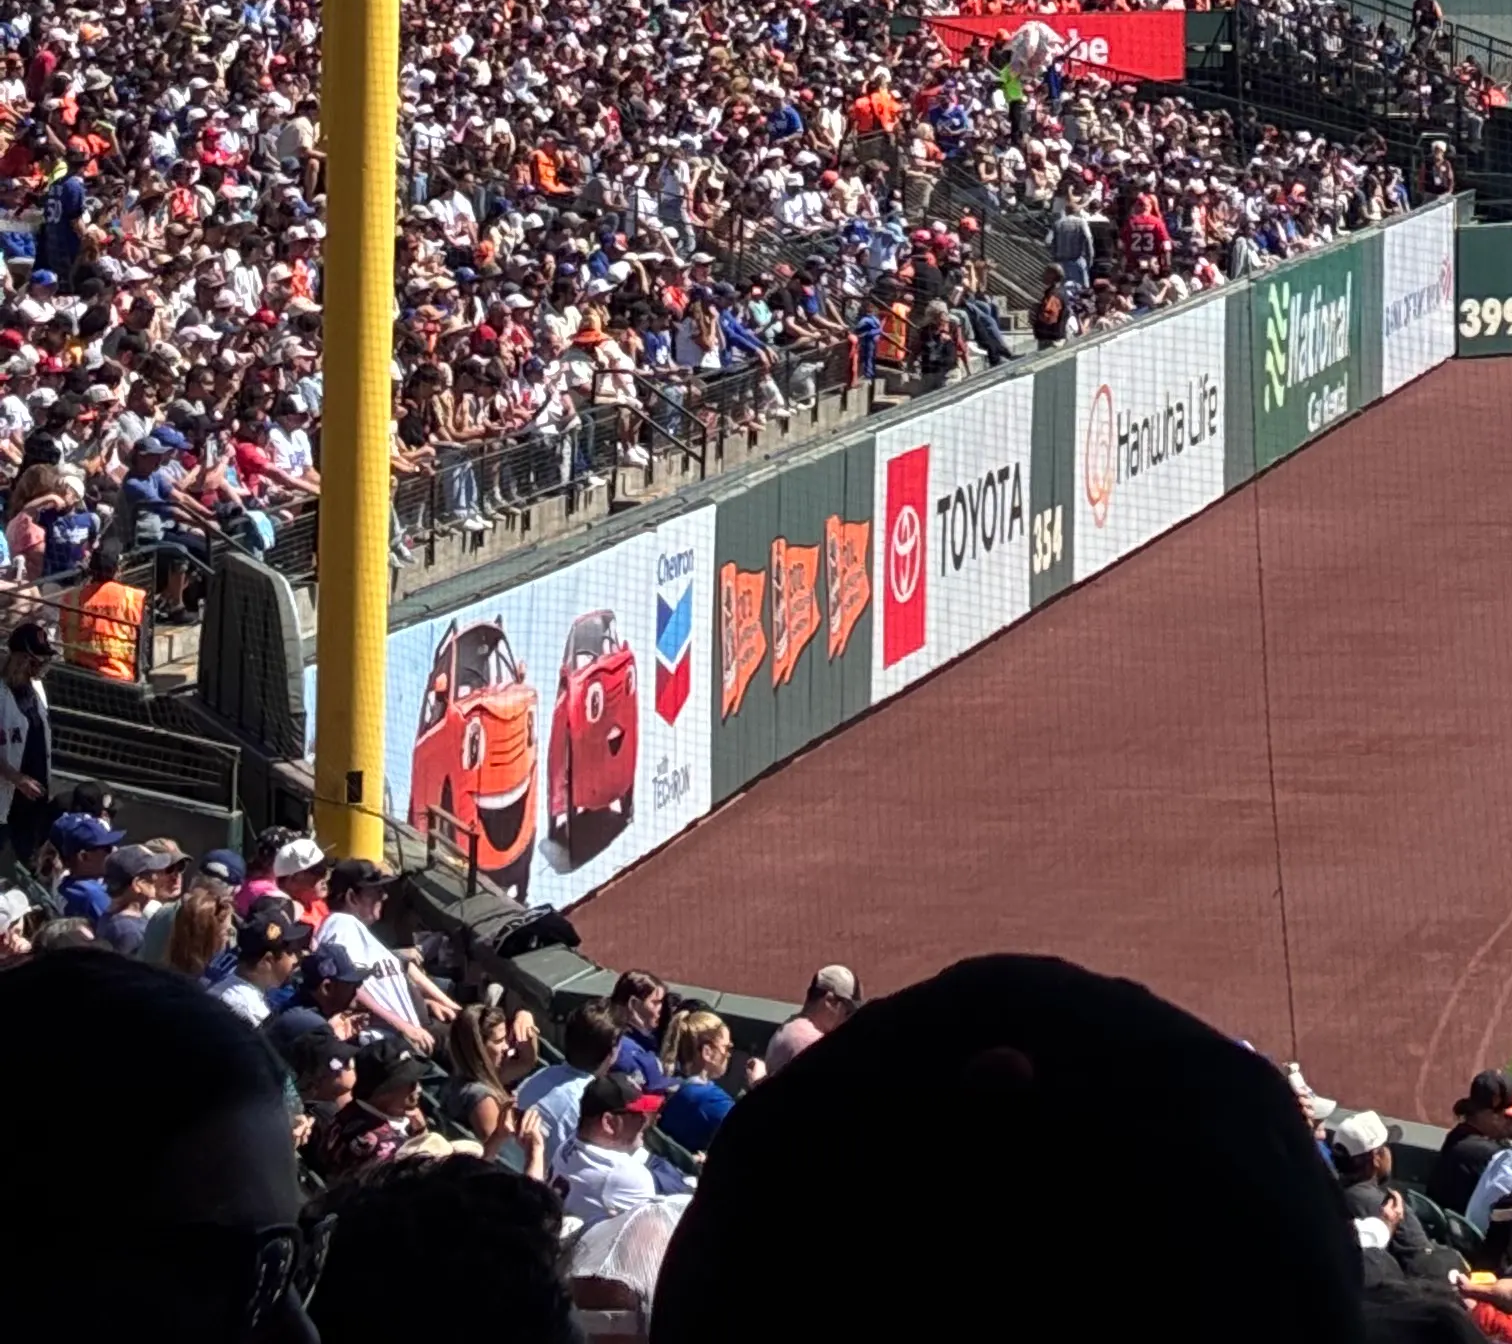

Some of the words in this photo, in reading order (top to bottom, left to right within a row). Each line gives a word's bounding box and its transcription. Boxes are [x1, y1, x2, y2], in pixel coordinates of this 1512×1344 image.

[1131, 233, 1154, 251] 23
[1287, 271, 1351, 387] National
[1116, 393, 1185, 483] Hanwha
[1188, 374, 1218, 446] Life
[937, 462, 1025, 576] TOYOTA
[1032, 505, 1063, 573] 354
[658, 549, 694, 586] Chevron
